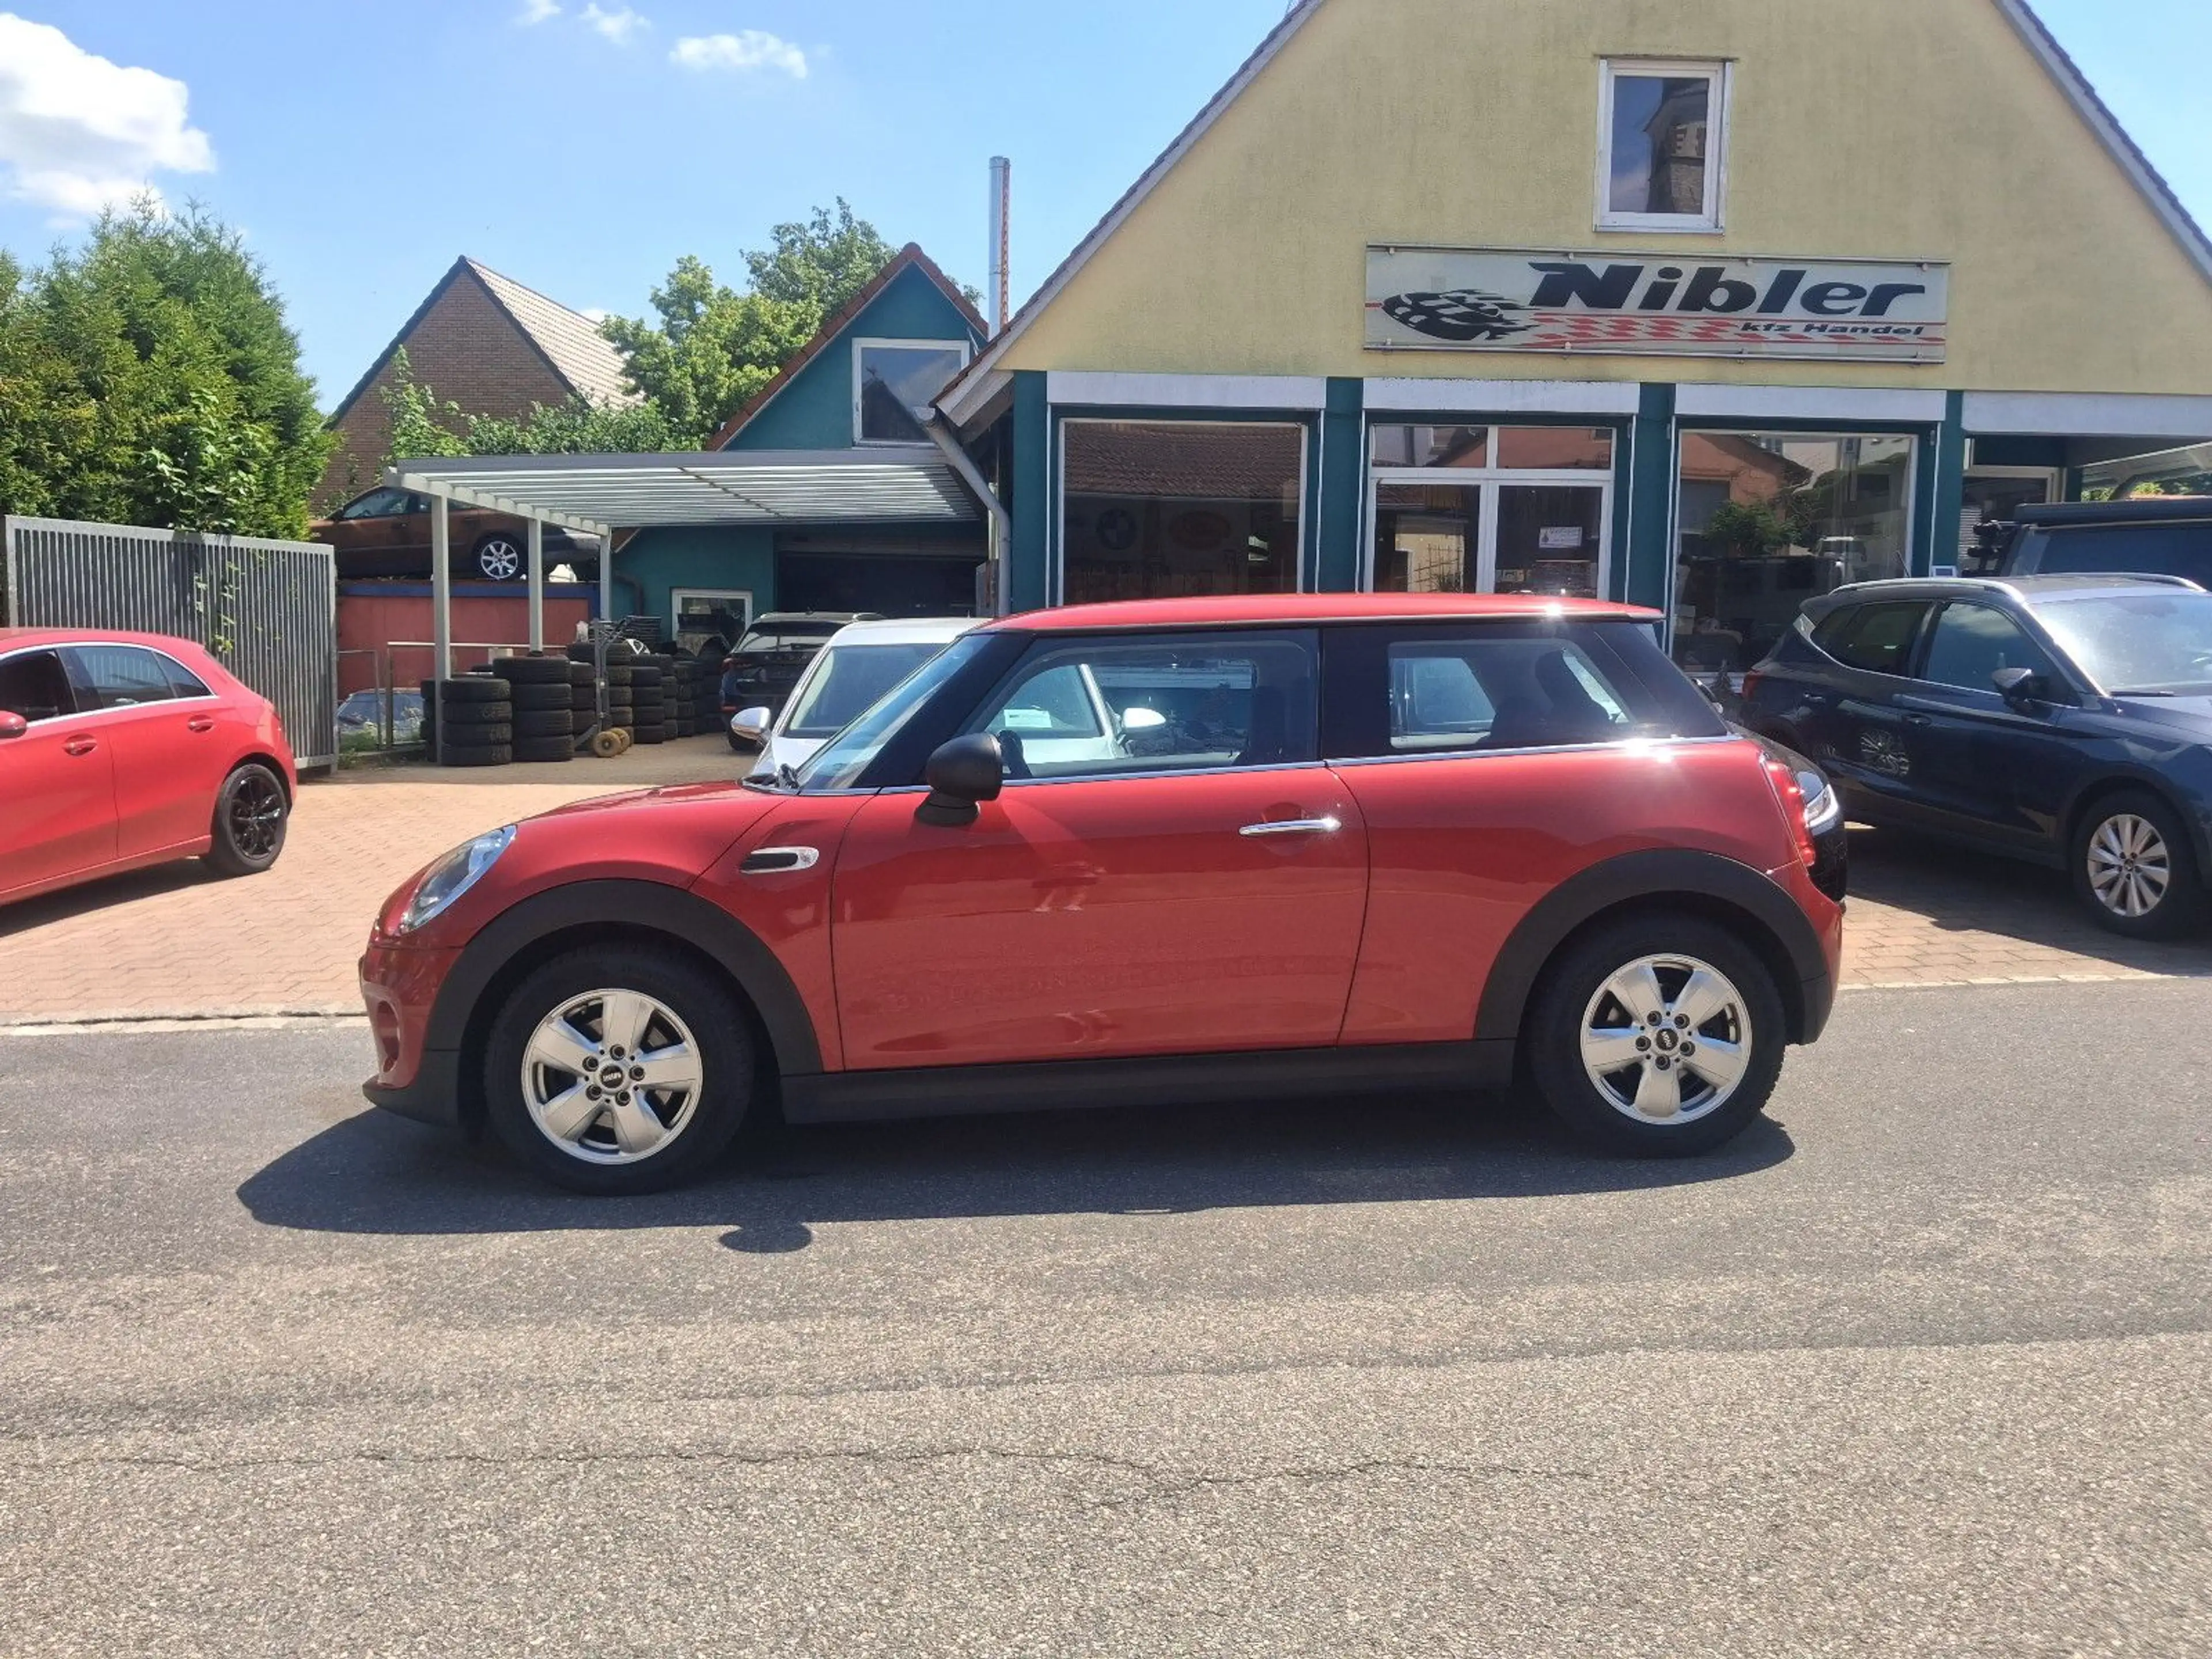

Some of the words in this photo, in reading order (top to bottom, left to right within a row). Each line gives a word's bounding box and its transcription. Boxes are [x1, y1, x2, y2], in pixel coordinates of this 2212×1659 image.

[1528, 263, 1925, 316] Nibler
[1741, 322, 1792, 332] kfz
[1803, 324, 1925, 335] Handel
